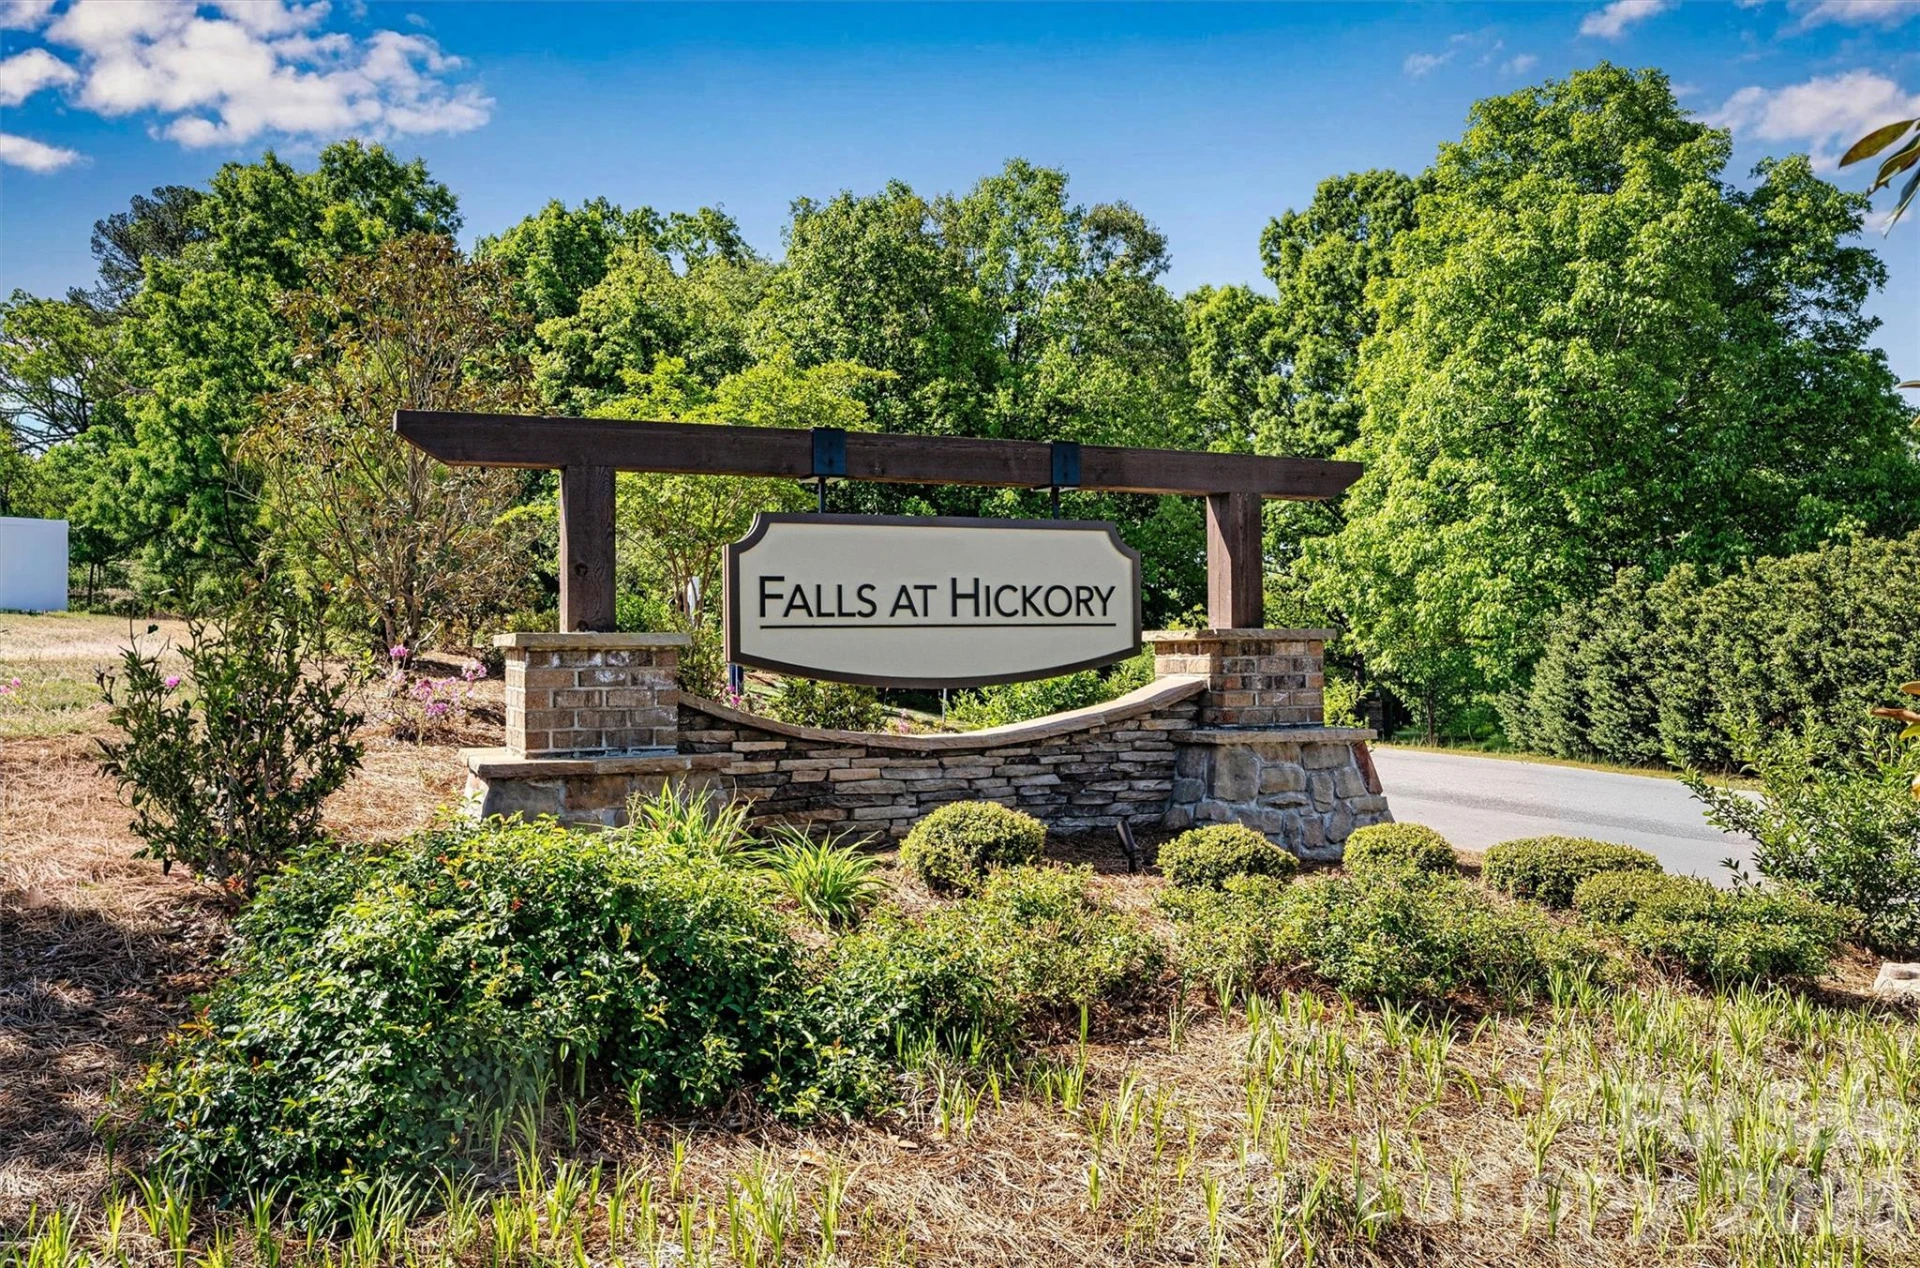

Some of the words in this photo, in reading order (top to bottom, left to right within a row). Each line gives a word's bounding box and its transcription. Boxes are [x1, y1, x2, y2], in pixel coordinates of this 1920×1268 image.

[758, 575, 877, 618] FALLS
[889, 584, 937, 618] AT
[950, 577, 1117, 618] HICKORY
